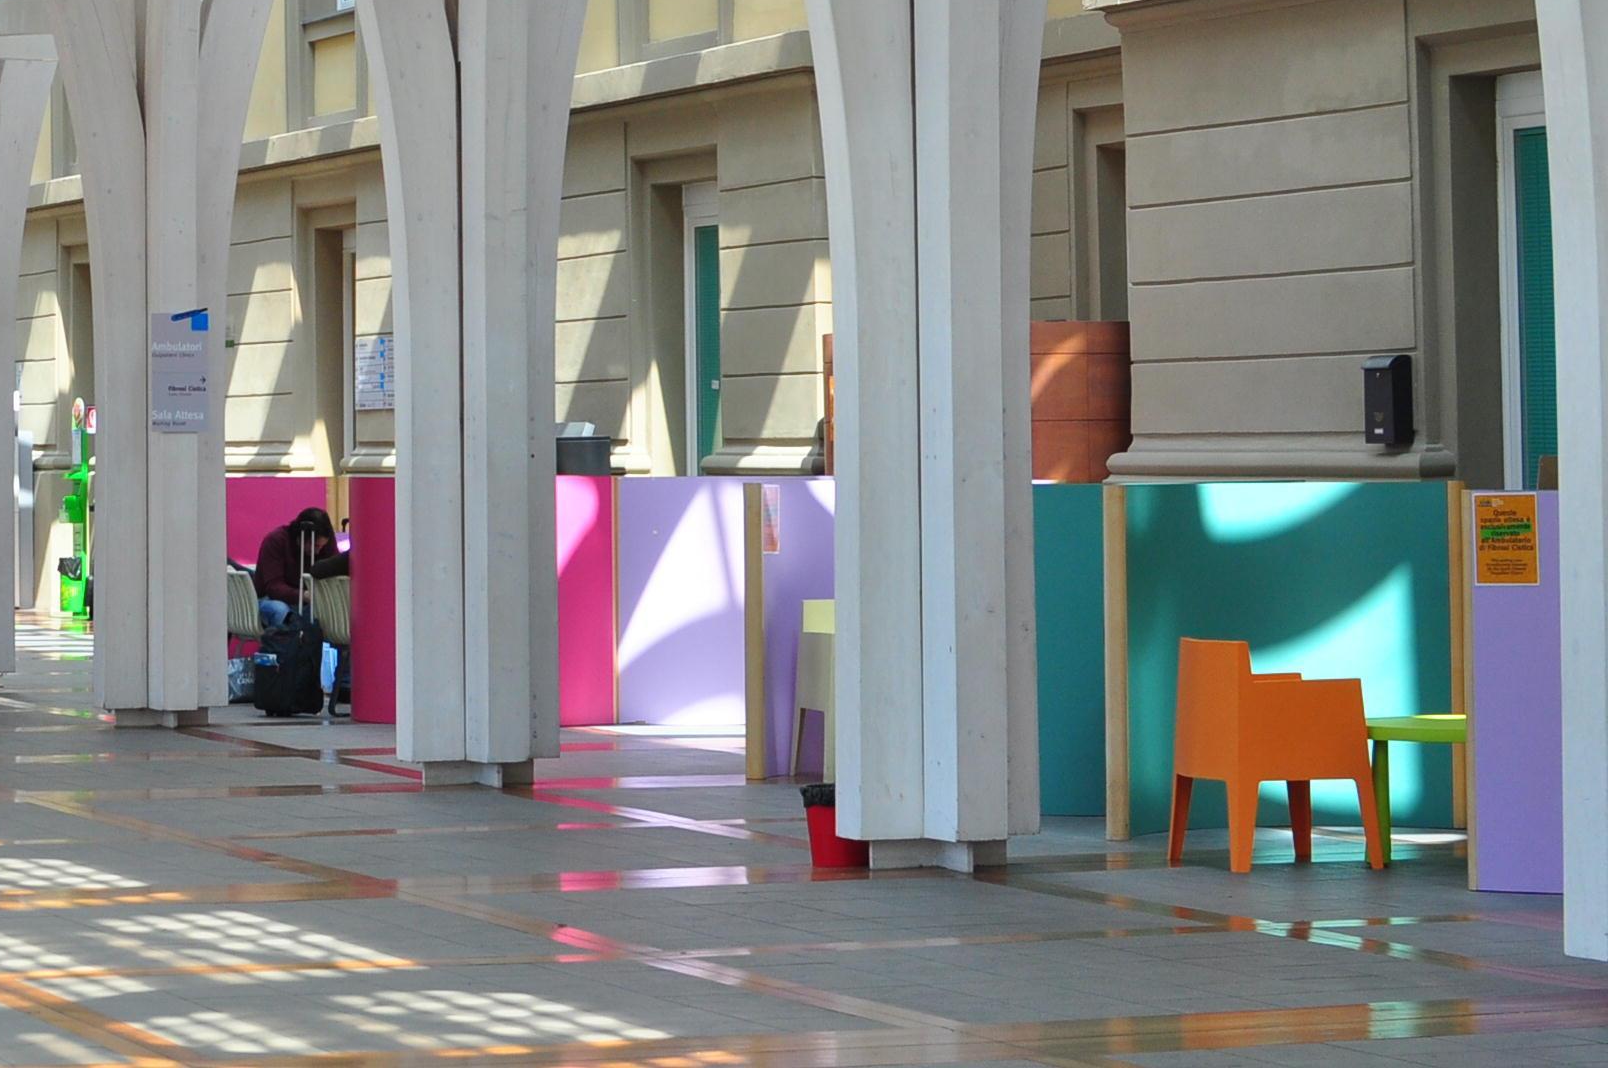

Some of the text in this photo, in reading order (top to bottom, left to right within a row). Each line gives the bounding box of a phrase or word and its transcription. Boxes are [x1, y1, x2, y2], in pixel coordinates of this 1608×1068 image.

[152, 341, 202, 351] Ambulatori
[152, 410, 205, 420] Sala Attesa
